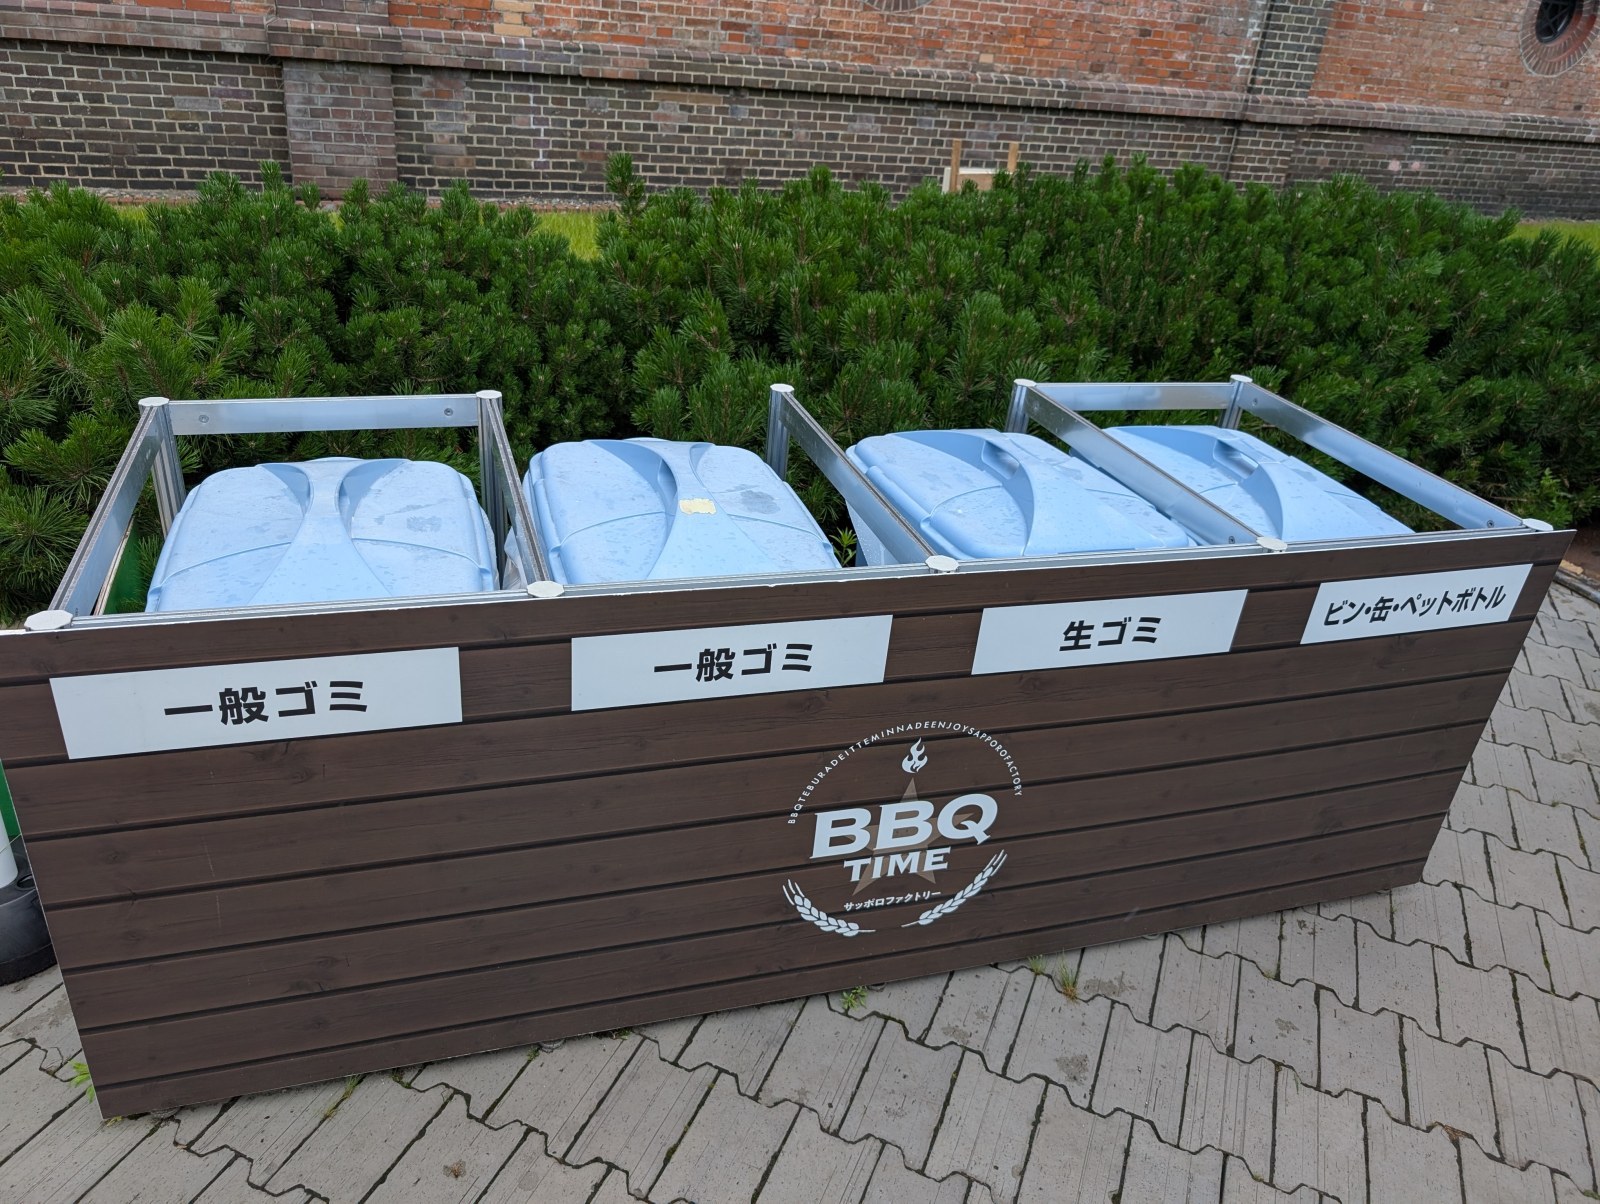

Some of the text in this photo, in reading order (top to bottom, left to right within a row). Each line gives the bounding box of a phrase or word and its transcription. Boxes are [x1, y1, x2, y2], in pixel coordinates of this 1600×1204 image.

[1324, 585, 1506, 626] ビン・缶・ペットボトル
[1059, 616, 1162, 652] 生ゴミ
[654, 643, 813, 682] 一般ゴミ
[164, 680, 368, 726] 一般ゴミ
[810, 793, 998, 859] BBQ
[843, 847, 951, 882] TIME
[843, 890, 942, 911] サッポロファクトリー
